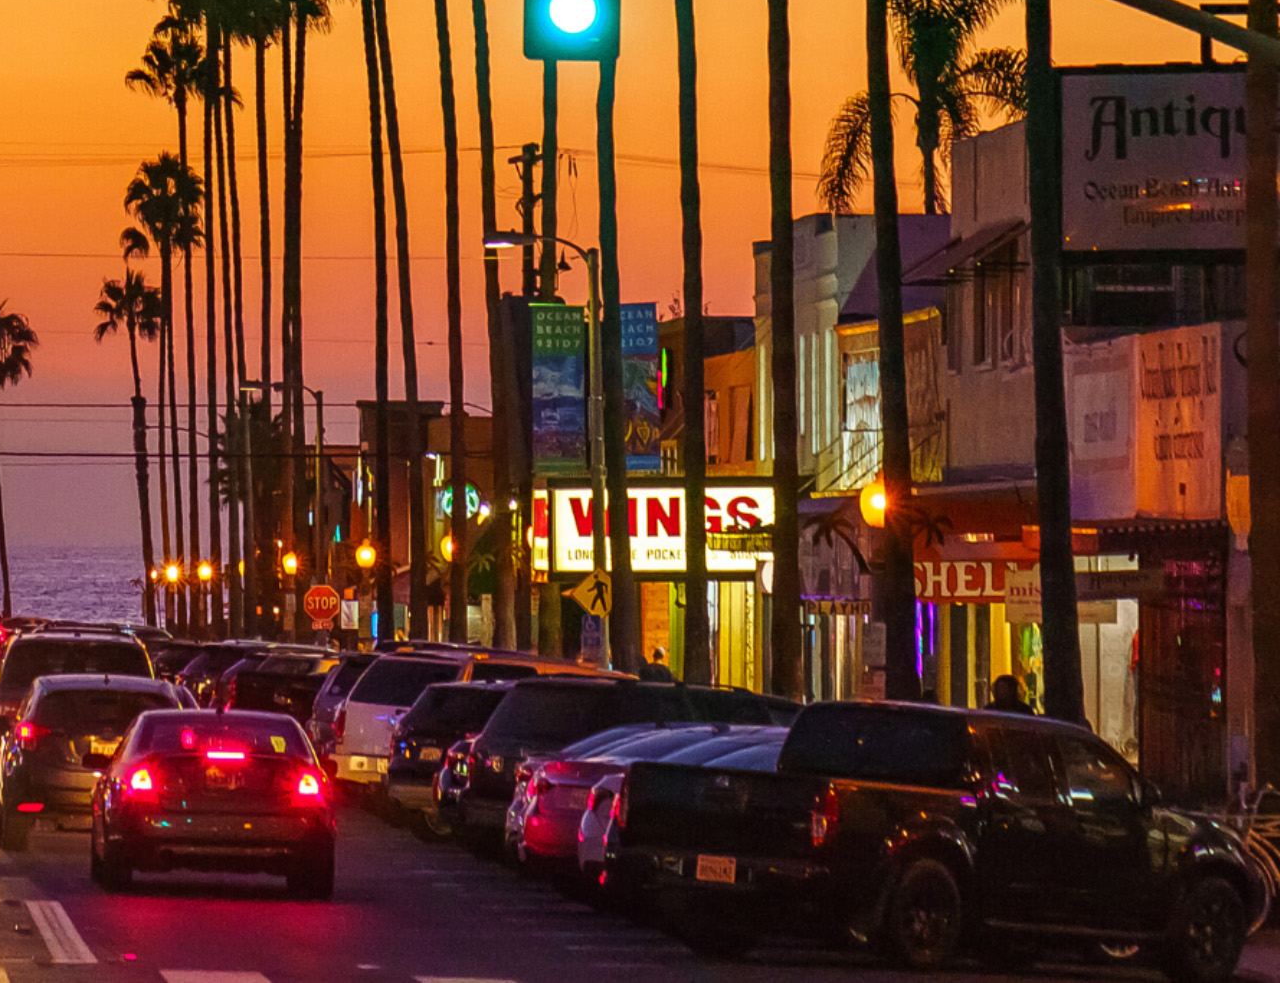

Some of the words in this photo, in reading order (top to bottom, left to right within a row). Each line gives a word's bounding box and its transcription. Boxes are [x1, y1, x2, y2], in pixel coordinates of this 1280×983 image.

[1084, 180, 1140, 201] Ocean
[536, 311, 581, 321] OCEAN
[620, 309, 653, 321] CEAN
[536, 324, 581, 334] BEACH
[536, 339, 581, 348] 92107
[307, 597, 338, 610] STOP
